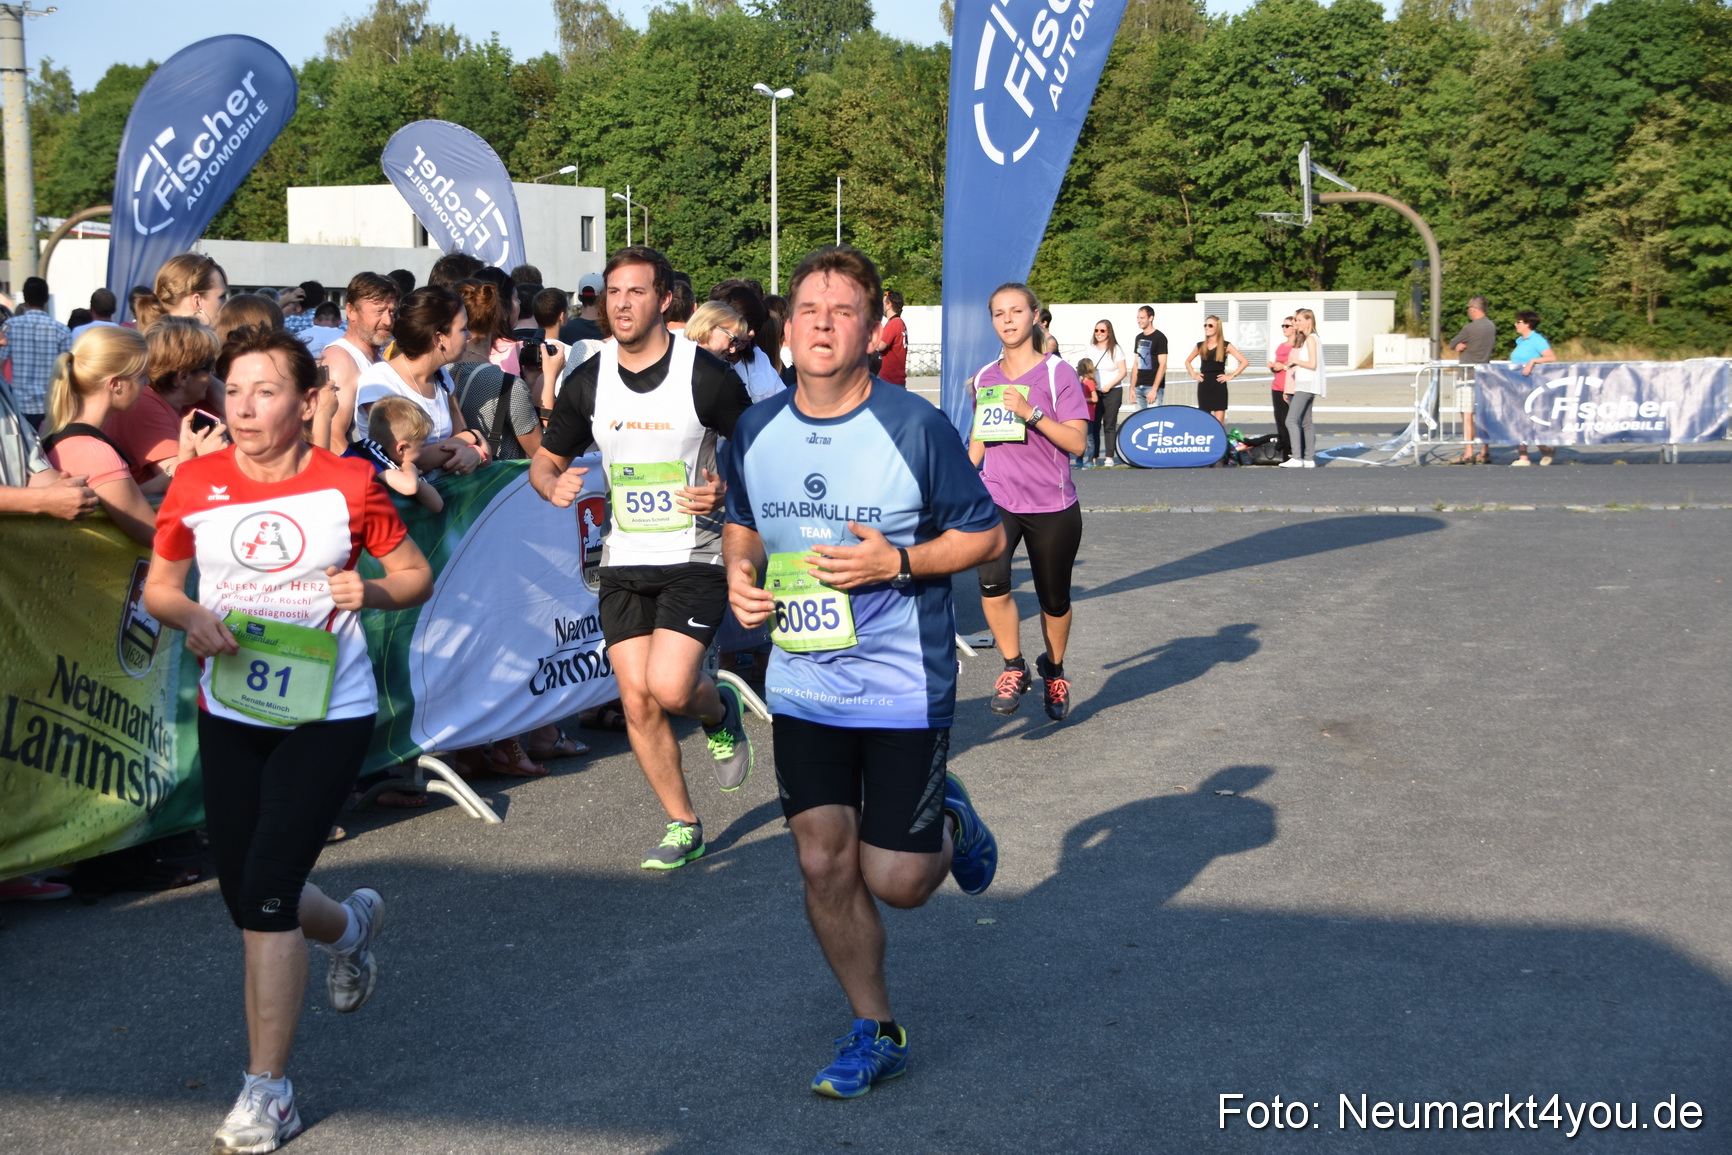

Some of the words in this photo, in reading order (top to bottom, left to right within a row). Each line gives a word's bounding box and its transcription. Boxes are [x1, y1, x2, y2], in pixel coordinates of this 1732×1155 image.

[154, 70, 258, 212] Fischer
[186, 99, 268, 211] AUTOMOBILE
[982, 408, 1013, 425] 294
[1551, 395, 1675, 419] Fischer
[626, 421, 675, 430] KLEBL
[1562, 421, 1665, 432] AUTOMOBILE
[1147, 432, 1214, 447] Fischer
[626, 490, 672, 513] 593
[800, 527, 832, 539] TEAM
[216, 581, 257, 592] LAUFEN
[262, 583, 283, 592] MIT
[291, 581, 325, 592] HERZ
[775, 598, 840, 633] 6085
[124, 645, 145, 669] 1628
[246, 659, 292, 698] 81
[241, 694, 265, 707] Renate
[266, 701, 290, 713] Münch
[771, 686, 894, 706] www.schabmueller.de
